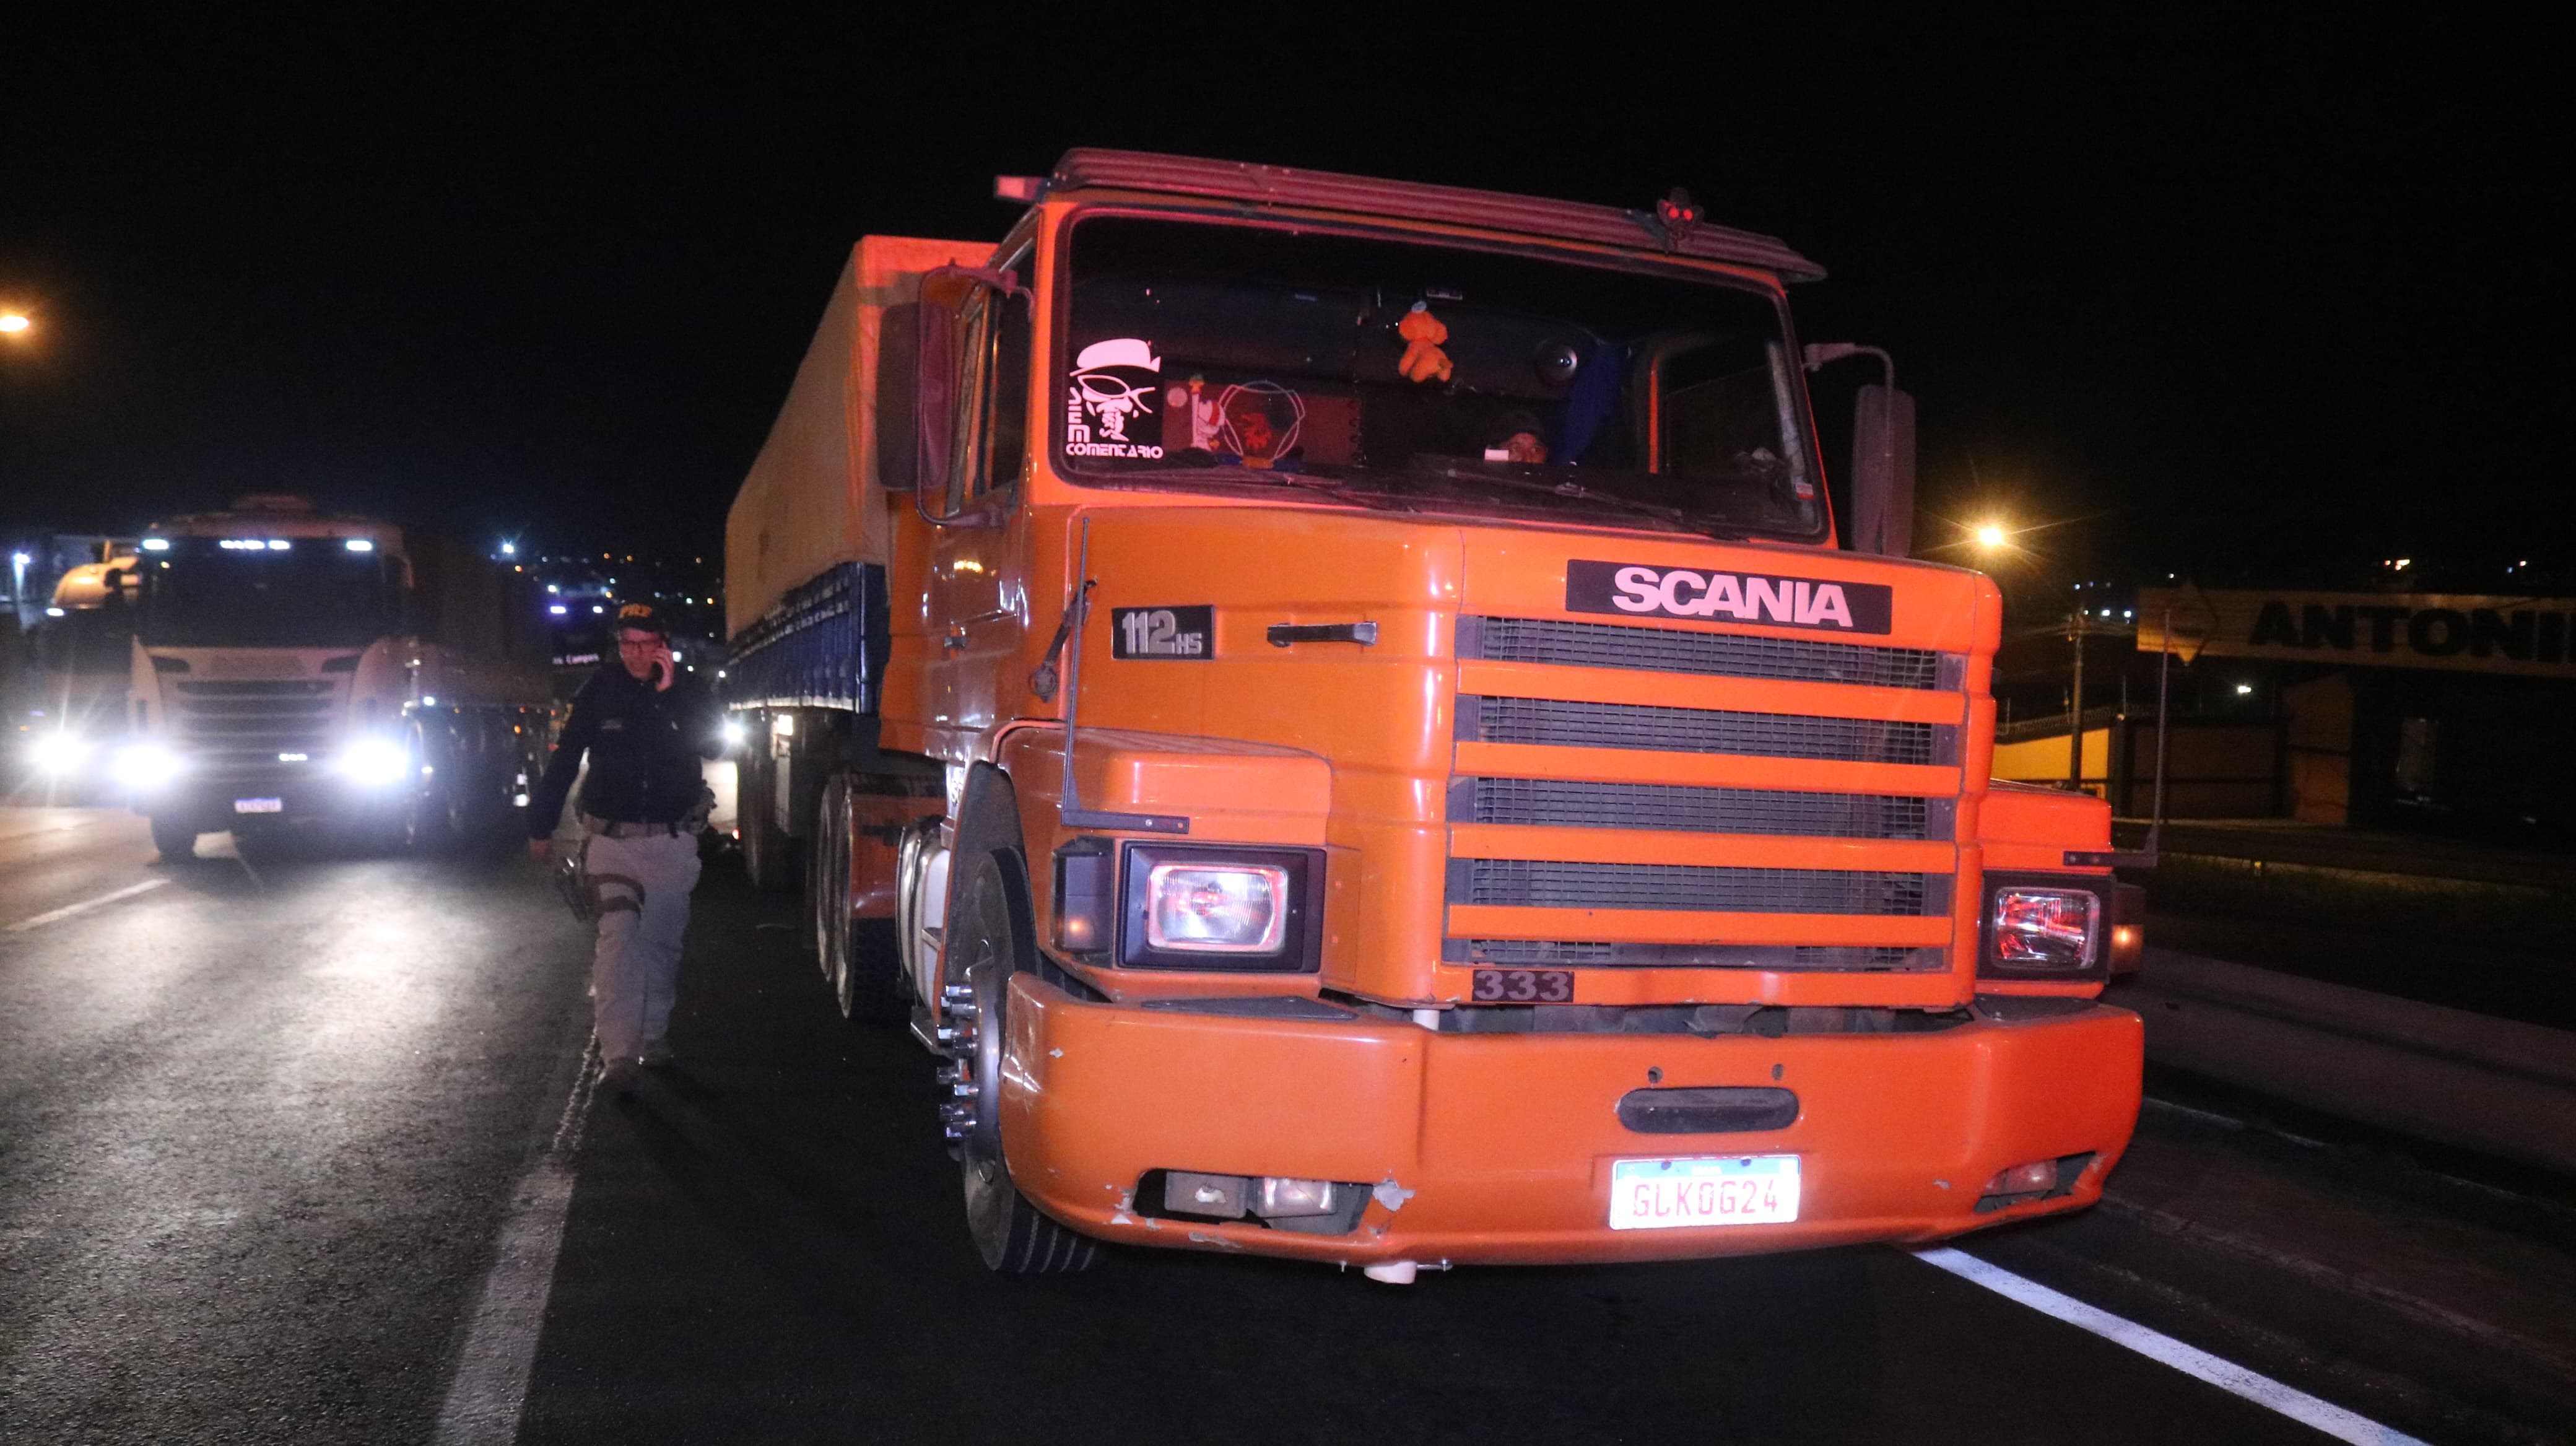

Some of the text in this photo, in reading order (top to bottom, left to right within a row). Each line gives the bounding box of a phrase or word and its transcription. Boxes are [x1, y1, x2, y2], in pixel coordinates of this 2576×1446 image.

[1066, 442, 1164, 459] COMENTARIO
[1612, 566, 1853, 627] SCANIA
[1121, 609, 1203, 655] 112 HS
[2249, 599, 2576, 663] ANTONI
[1474, 970, 1570, 1002] 333
